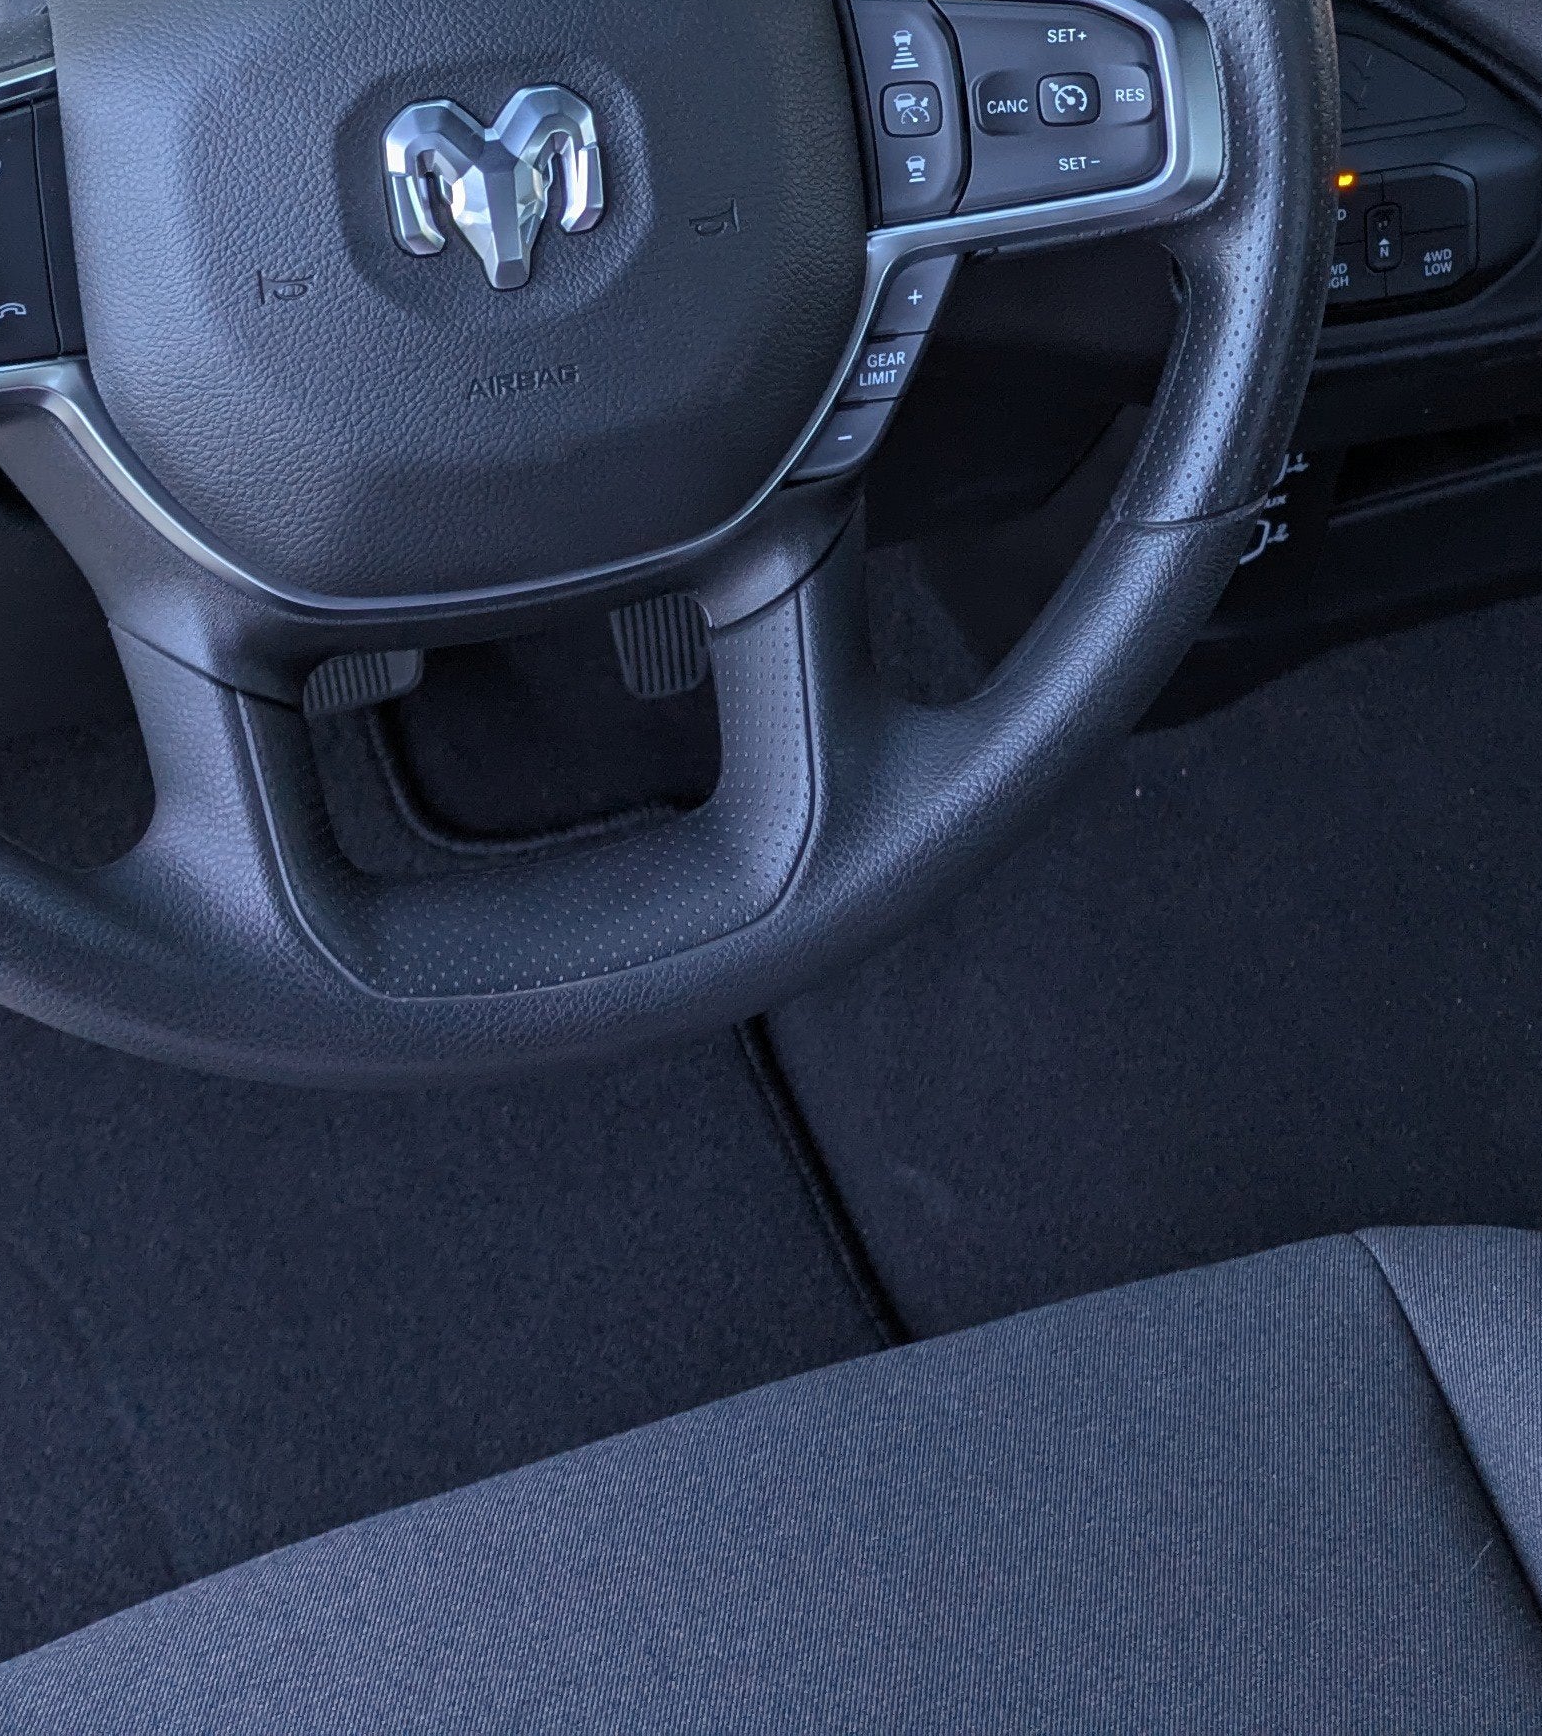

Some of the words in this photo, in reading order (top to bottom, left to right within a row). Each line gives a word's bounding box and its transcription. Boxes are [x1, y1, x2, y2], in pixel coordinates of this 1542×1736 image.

[1047, 29, 1088, 44] SET+
[1115, 89, 1145, 102] RES
[987, 99, 1028, 115] CANC
[1380, 246, 1389, 258] N
[1423, 248, 1452, 263] 4WD
[1424, 261, 1453, 277] LOW
[867, 350, 906, 367] GEAR
[467, 365, 580, 401] AIRBAG
[859, 368, 896, 386] LIMIT
